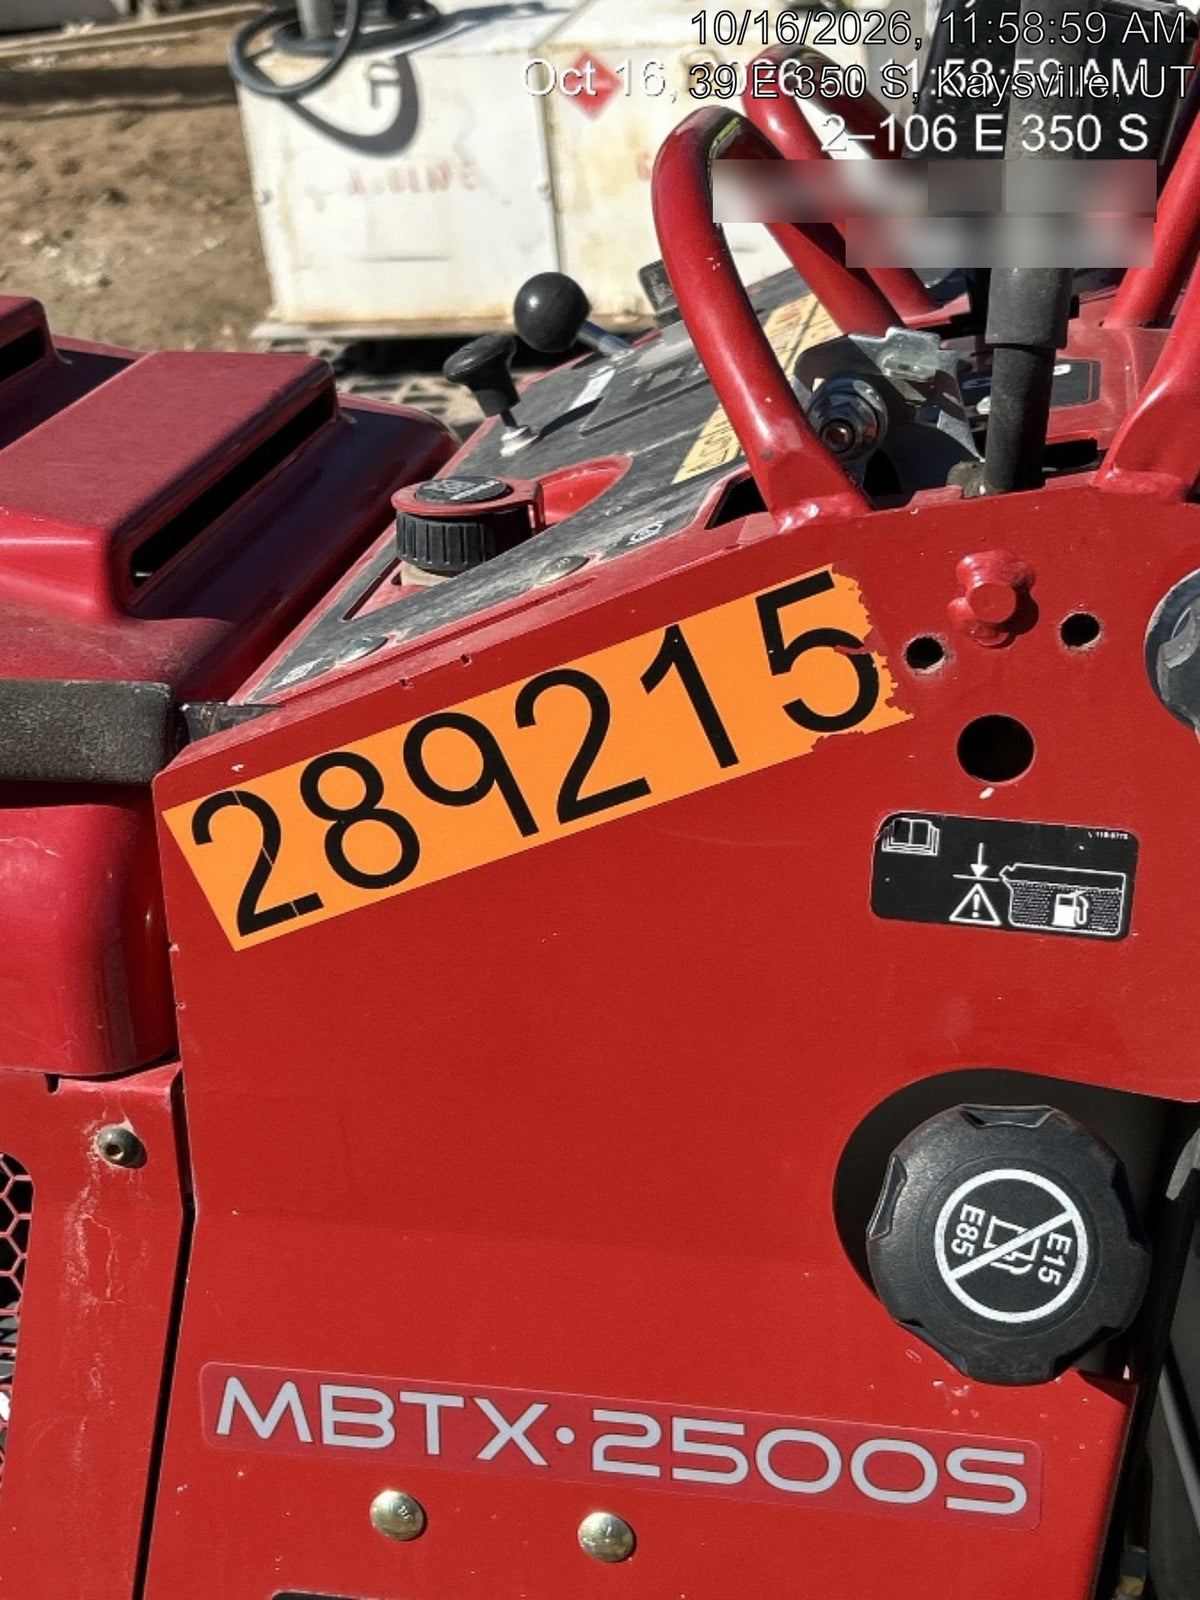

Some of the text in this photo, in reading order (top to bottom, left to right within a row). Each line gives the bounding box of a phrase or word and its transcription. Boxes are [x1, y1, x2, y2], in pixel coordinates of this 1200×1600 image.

[191, 570, 880, 936] 289215
[950, 1203, 986, 1258] E85
[1037, 1232, 1073, 1286] E15
